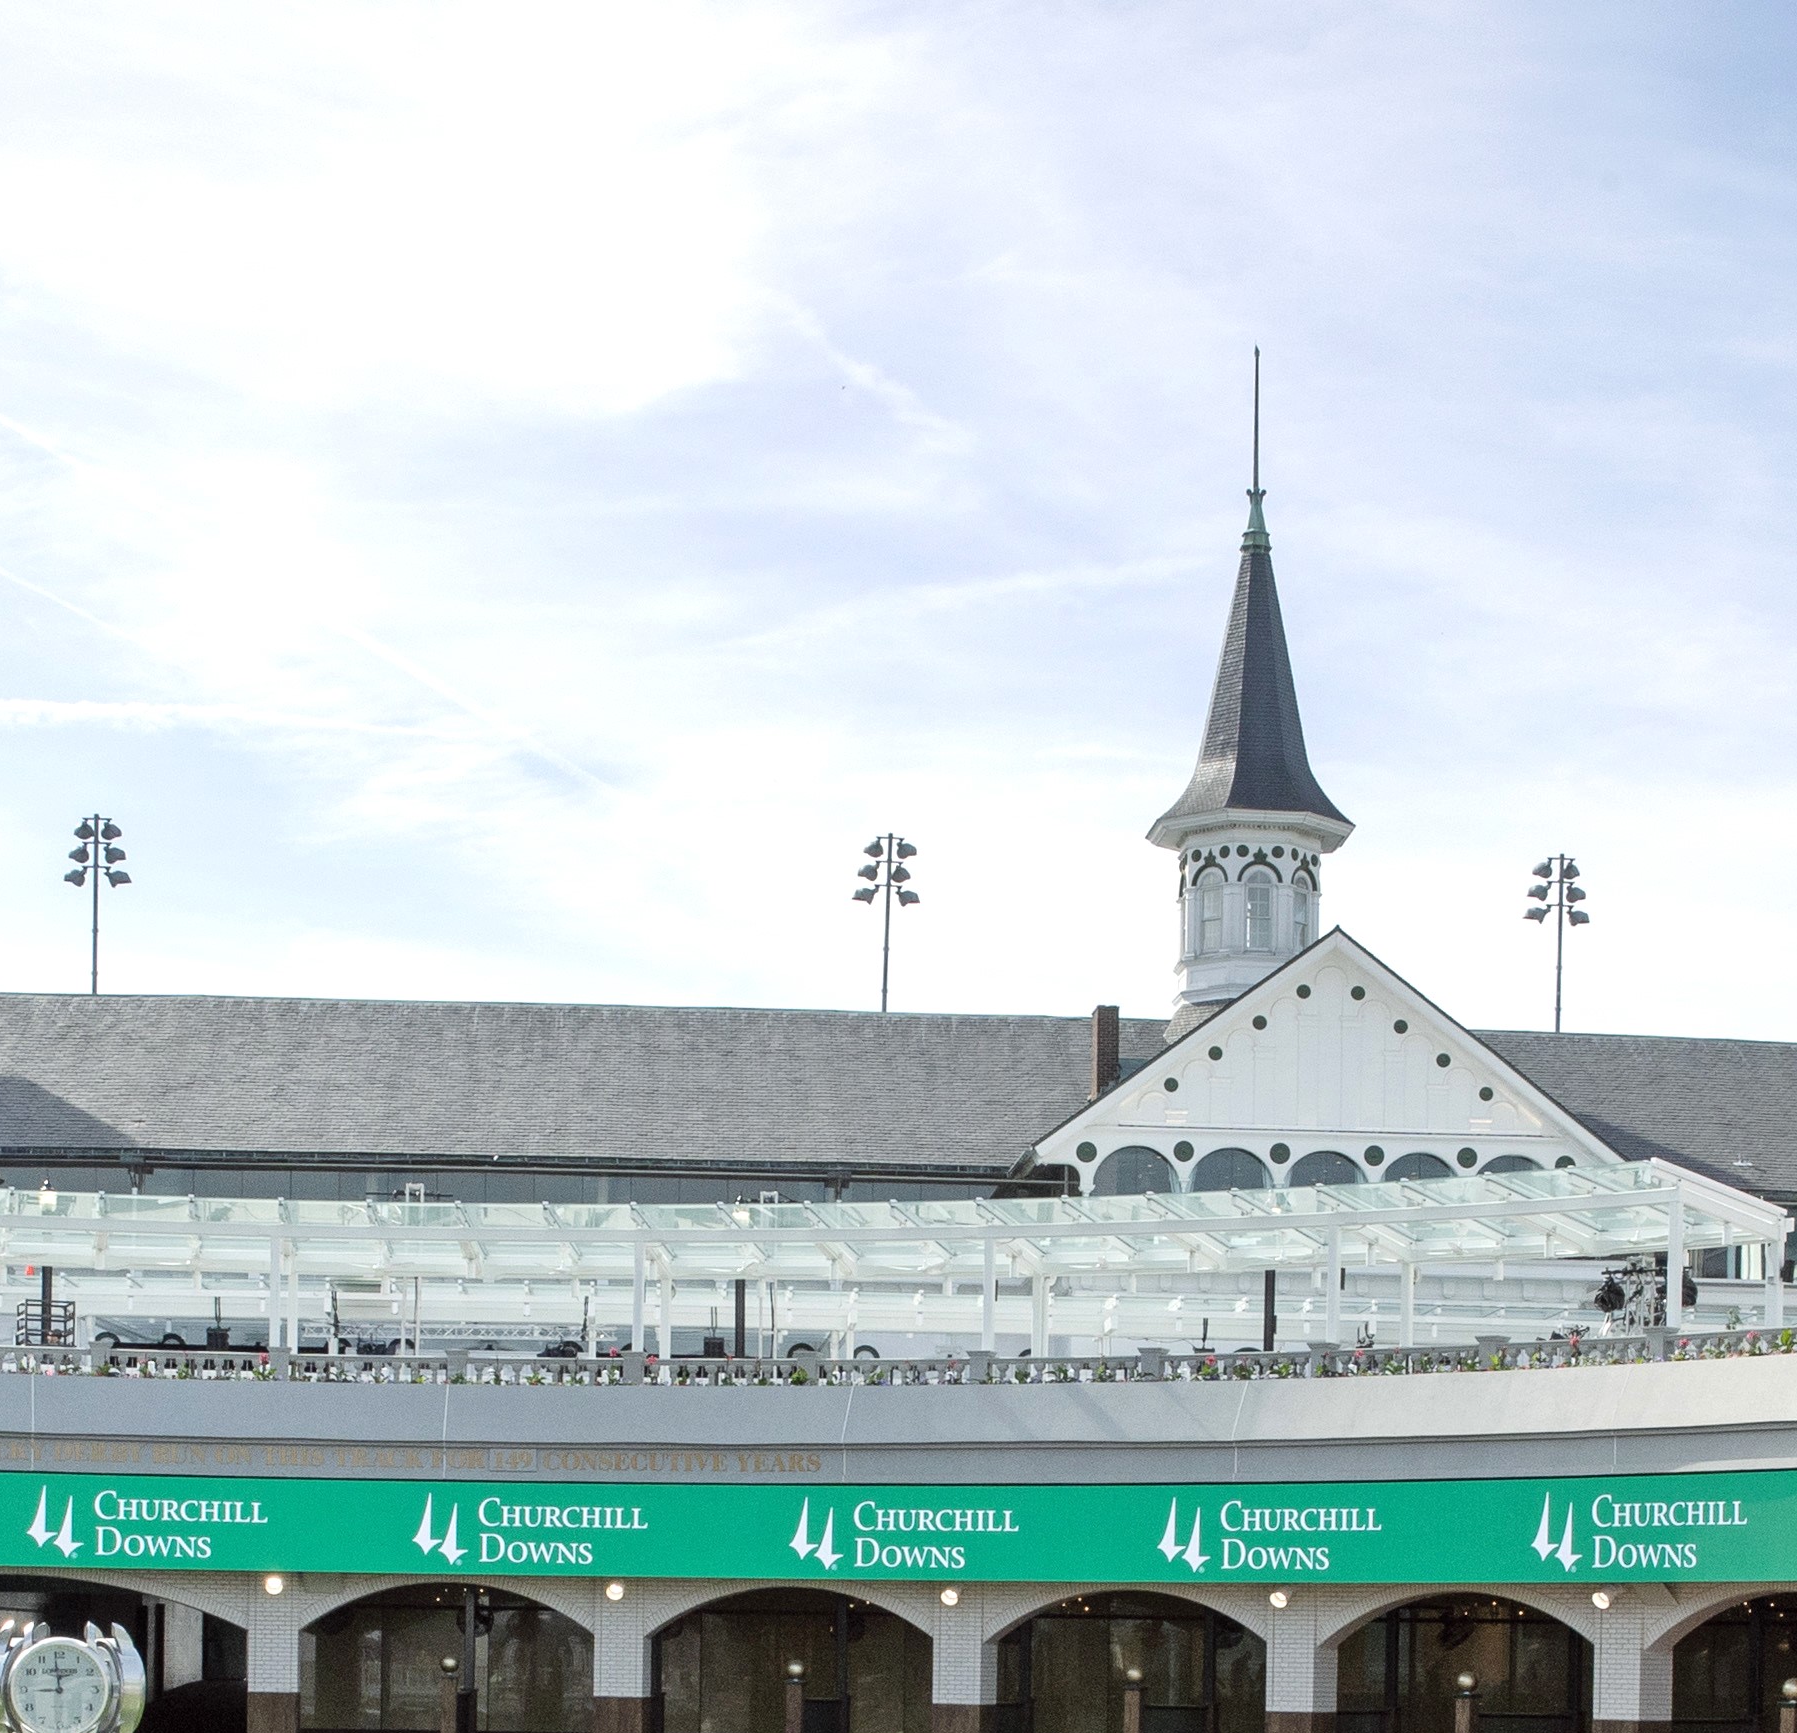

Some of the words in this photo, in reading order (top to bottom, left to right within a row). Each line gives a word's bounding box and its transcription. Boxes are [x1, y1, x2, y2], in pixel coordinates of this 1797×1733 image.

[213, 1445, 252, 1465] ON
[263, 1445, 325, 1466] THIS
[335, 1447, 424, 1469] TRACK
[430, 1449, 485, 1469] FOR
[493, 1451, 533, 1470] 149
[542, 1451, 728, 1472] CONSECUTIVE
[736, 1452, 823, 1473] YEARS
[93, 1490, 268, 1524] CHURCHILL
[478, 1497, 649, 1529] CHURCHILL
[853, 1500, 1020, 1532] CHURCHILL
[1220, 1500, 1382, 1532] CHURCHILL
[1591, 1493, 1748, 1528] CHURCHILL
[94, 1525, 212, 1559] DOWNS
[478, 1533, 593, 1565] DOWNS
[854, 1537, 966, 1569] DOWNS
[1221, 1538, 1330, 1571] DOWNS
[1591, 1535, 1698, 1569] DOWNS
